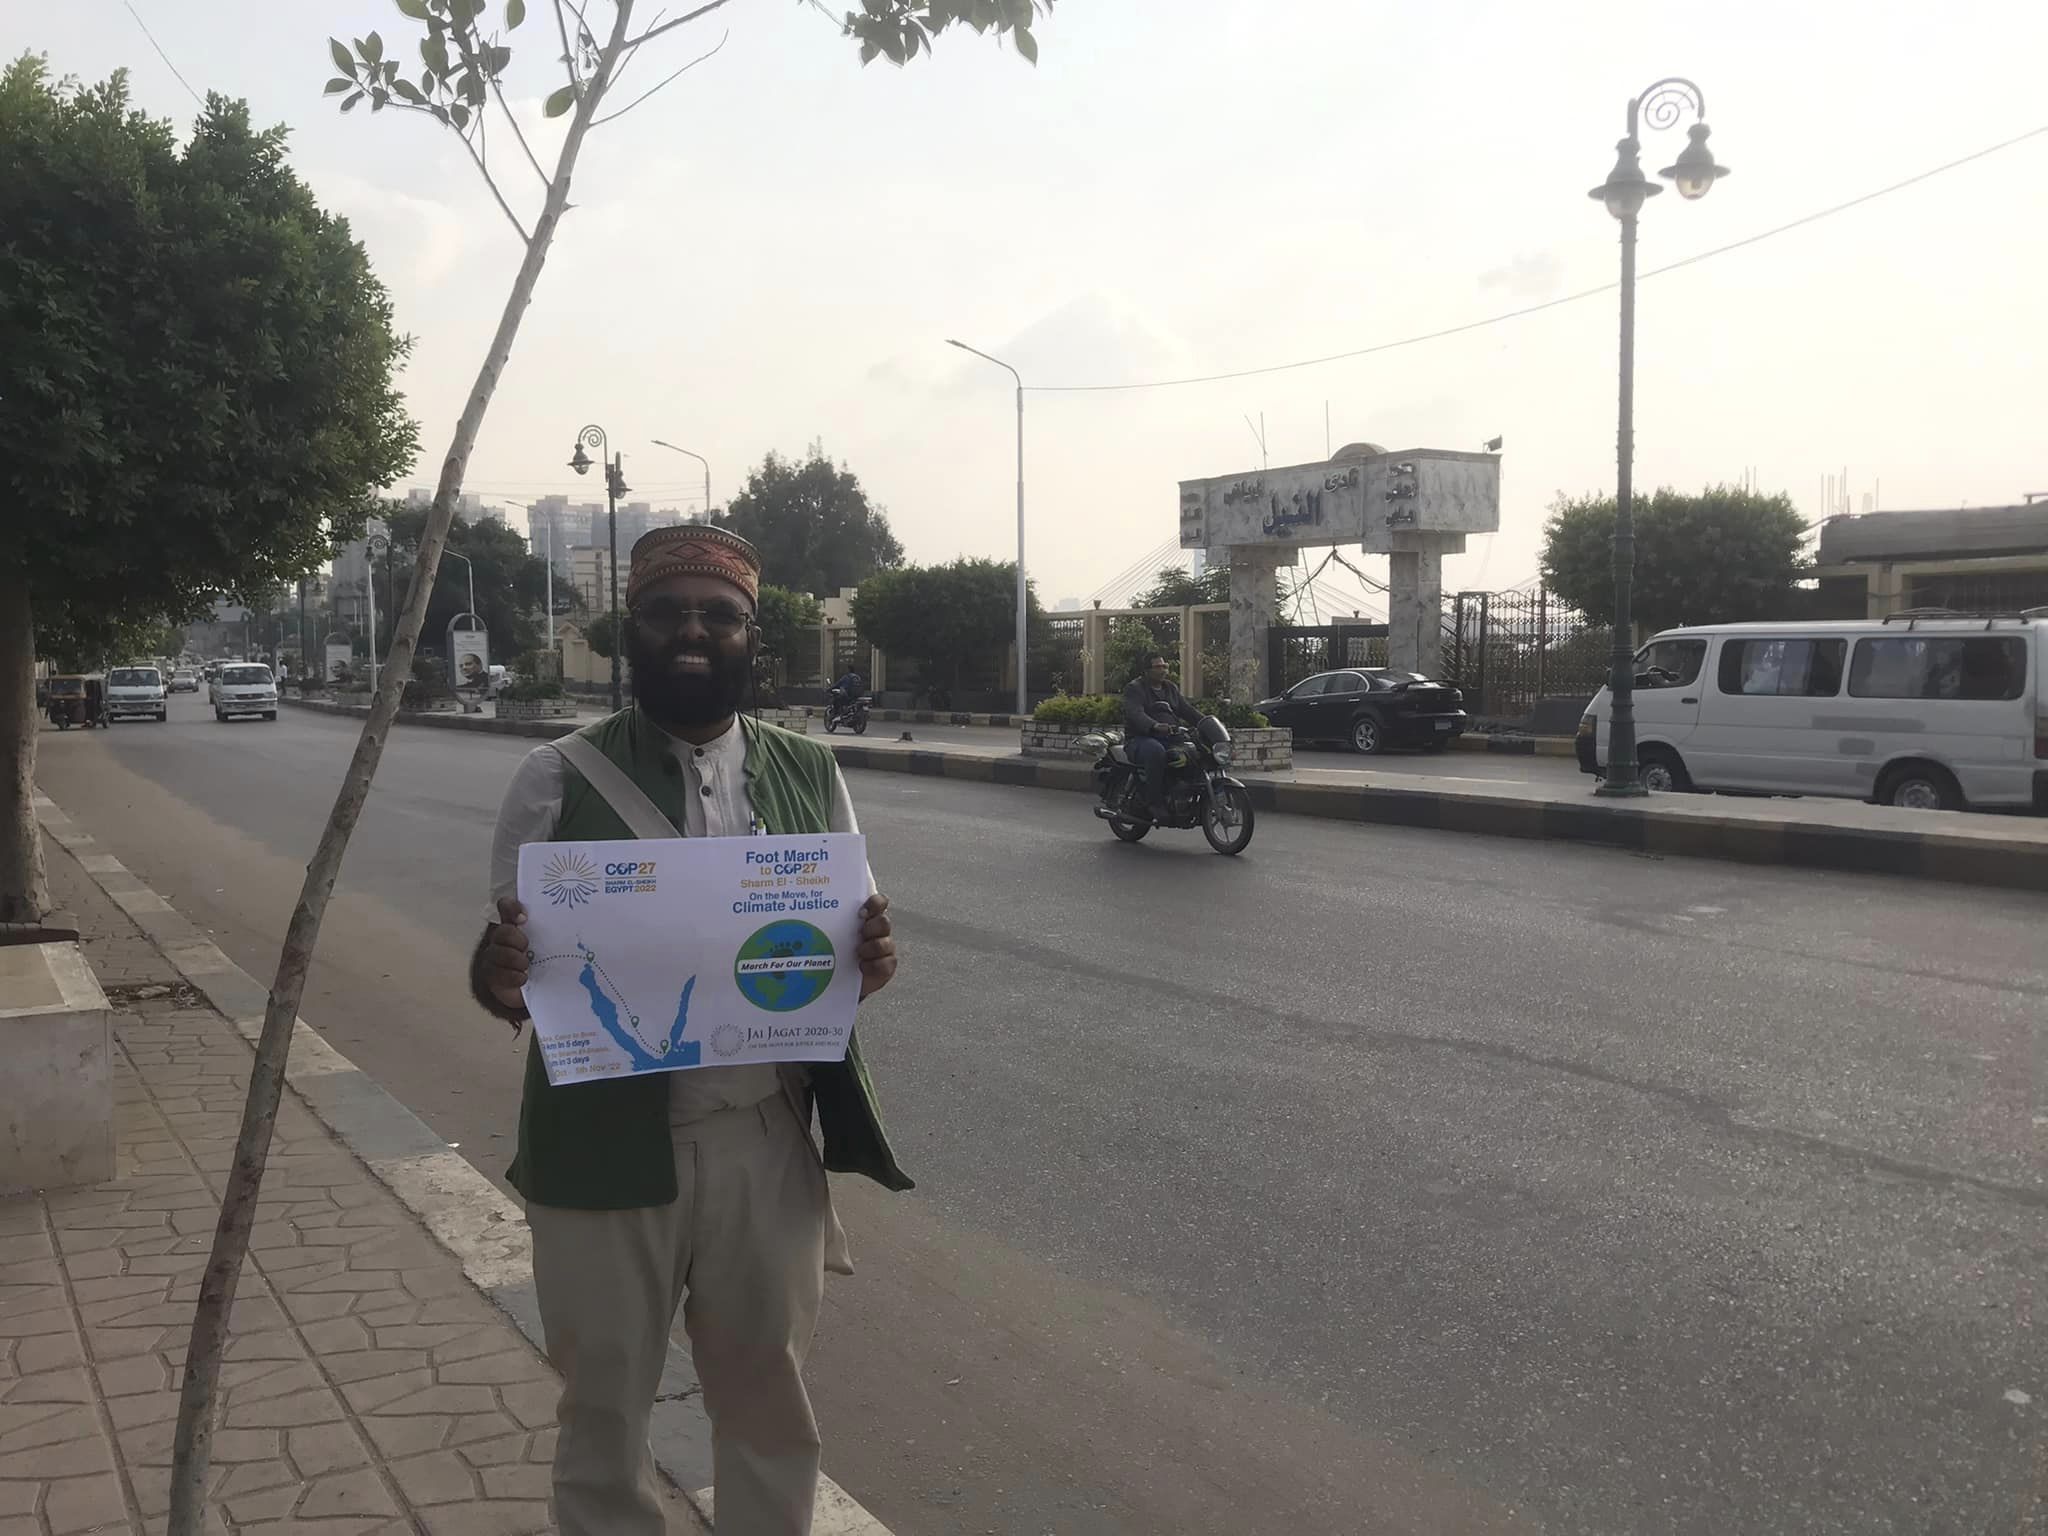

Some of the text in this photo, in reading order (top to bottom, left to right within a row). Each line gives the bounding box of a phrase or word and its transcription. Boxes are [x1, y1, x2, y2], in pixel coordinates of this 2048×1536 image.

[746, 848, 828, 864] Foot March
[605, 862, 656, 876] COP27
[760, 863, 818, 876] to COP27
[635, 884, 656, 892] 2022
[741, 878, 774, 889] Sharm
[776, 877, 787, 887] El
[796, 876, 831, 886] Sheikh
[749, 889, 824, 901] On the Move, for
[732, 897, 839, 914] Climate Justice
[770, 961, 784, 969] For
[786, 960, 802, 968] Our
[803, 958, 831, 967] Planet
[804, 1026, 843, 1037] 2020-30
[572, 1039, 590, 1048] days
[572, 1056, 590, 1065] days
[589, 1064, 607, 1073] Nov
